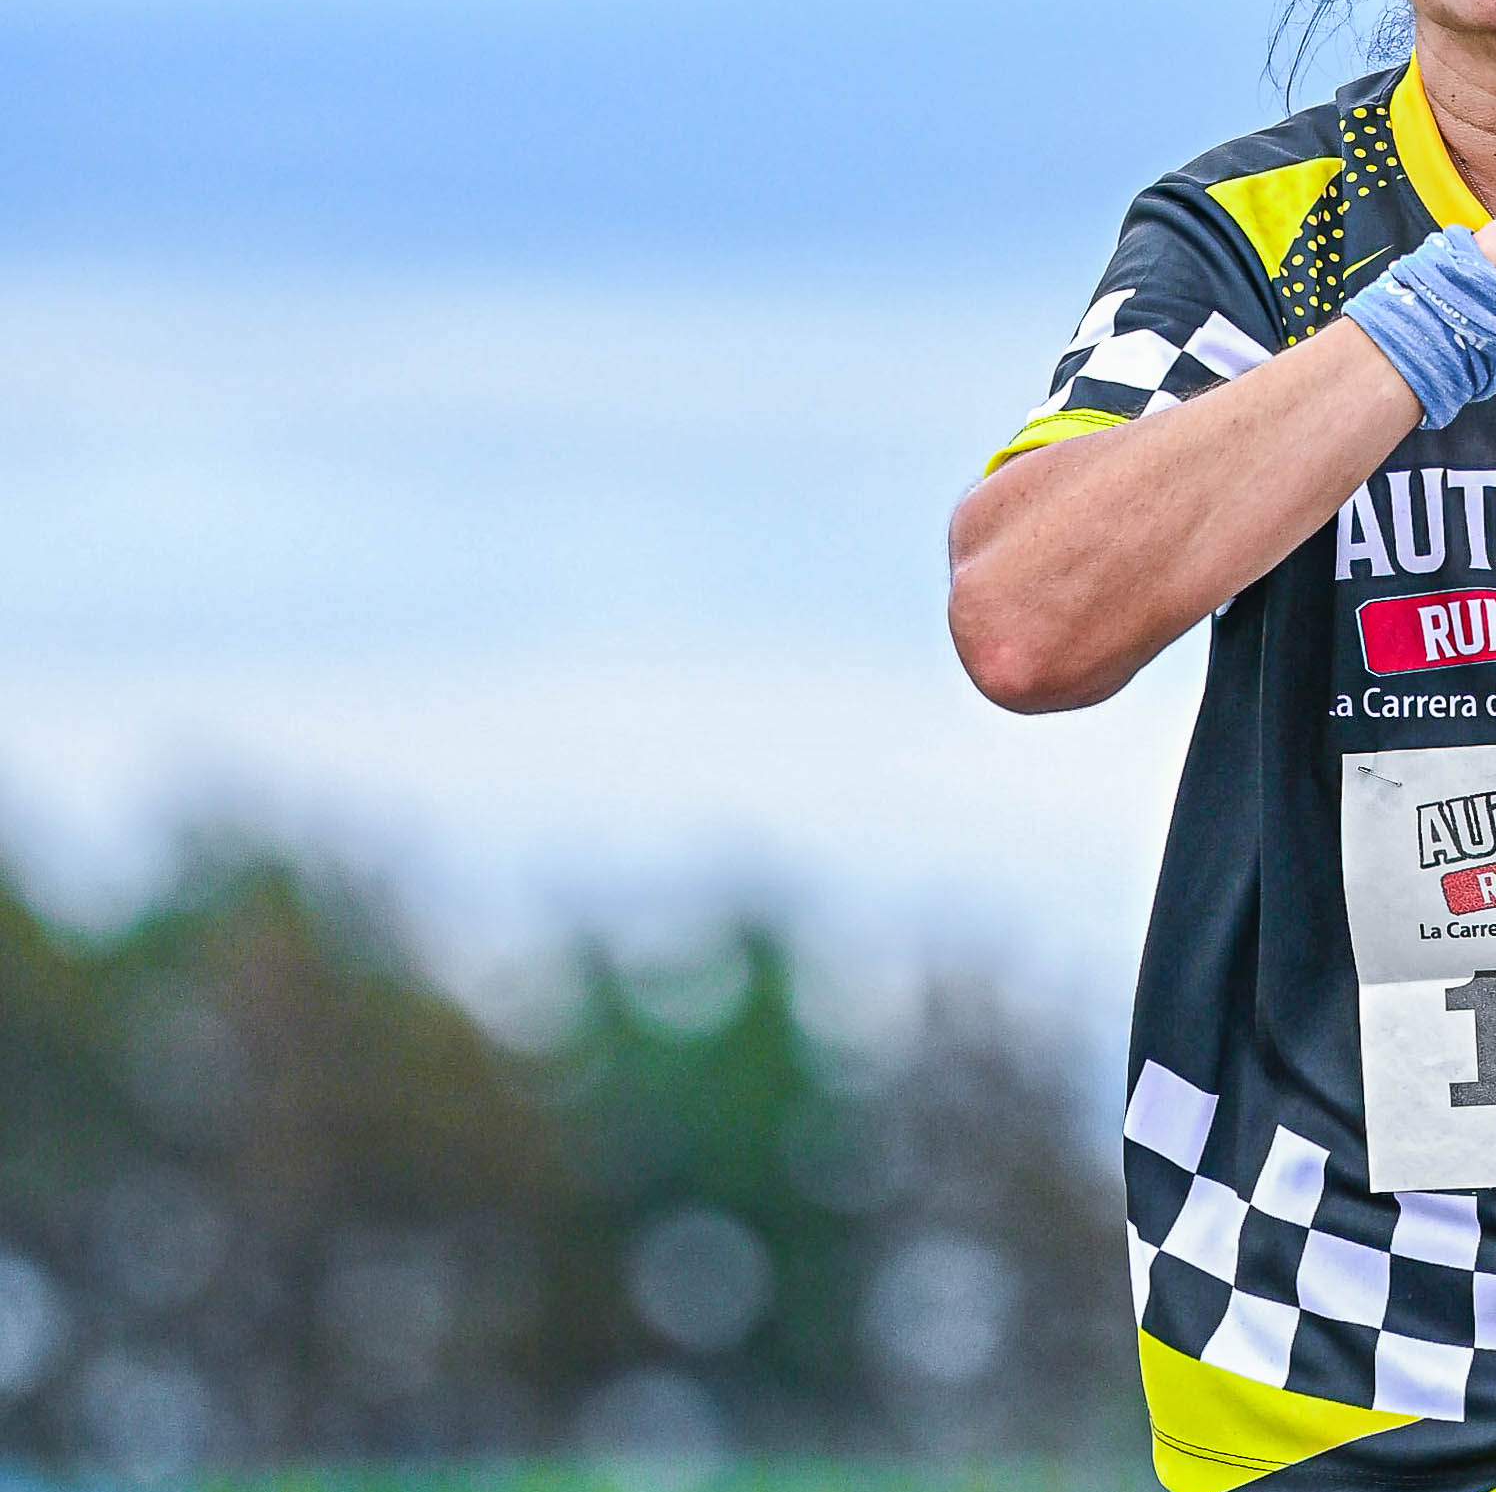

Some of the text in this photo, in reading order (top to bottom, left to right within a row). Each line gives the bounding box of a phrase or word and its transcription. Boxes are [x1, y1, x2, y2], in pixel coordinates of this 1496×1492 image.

[1328, 693, 1353, 717] a
[1362, 687, 1478, 718] Carrera
[1419, 923, 1442, 940] La
